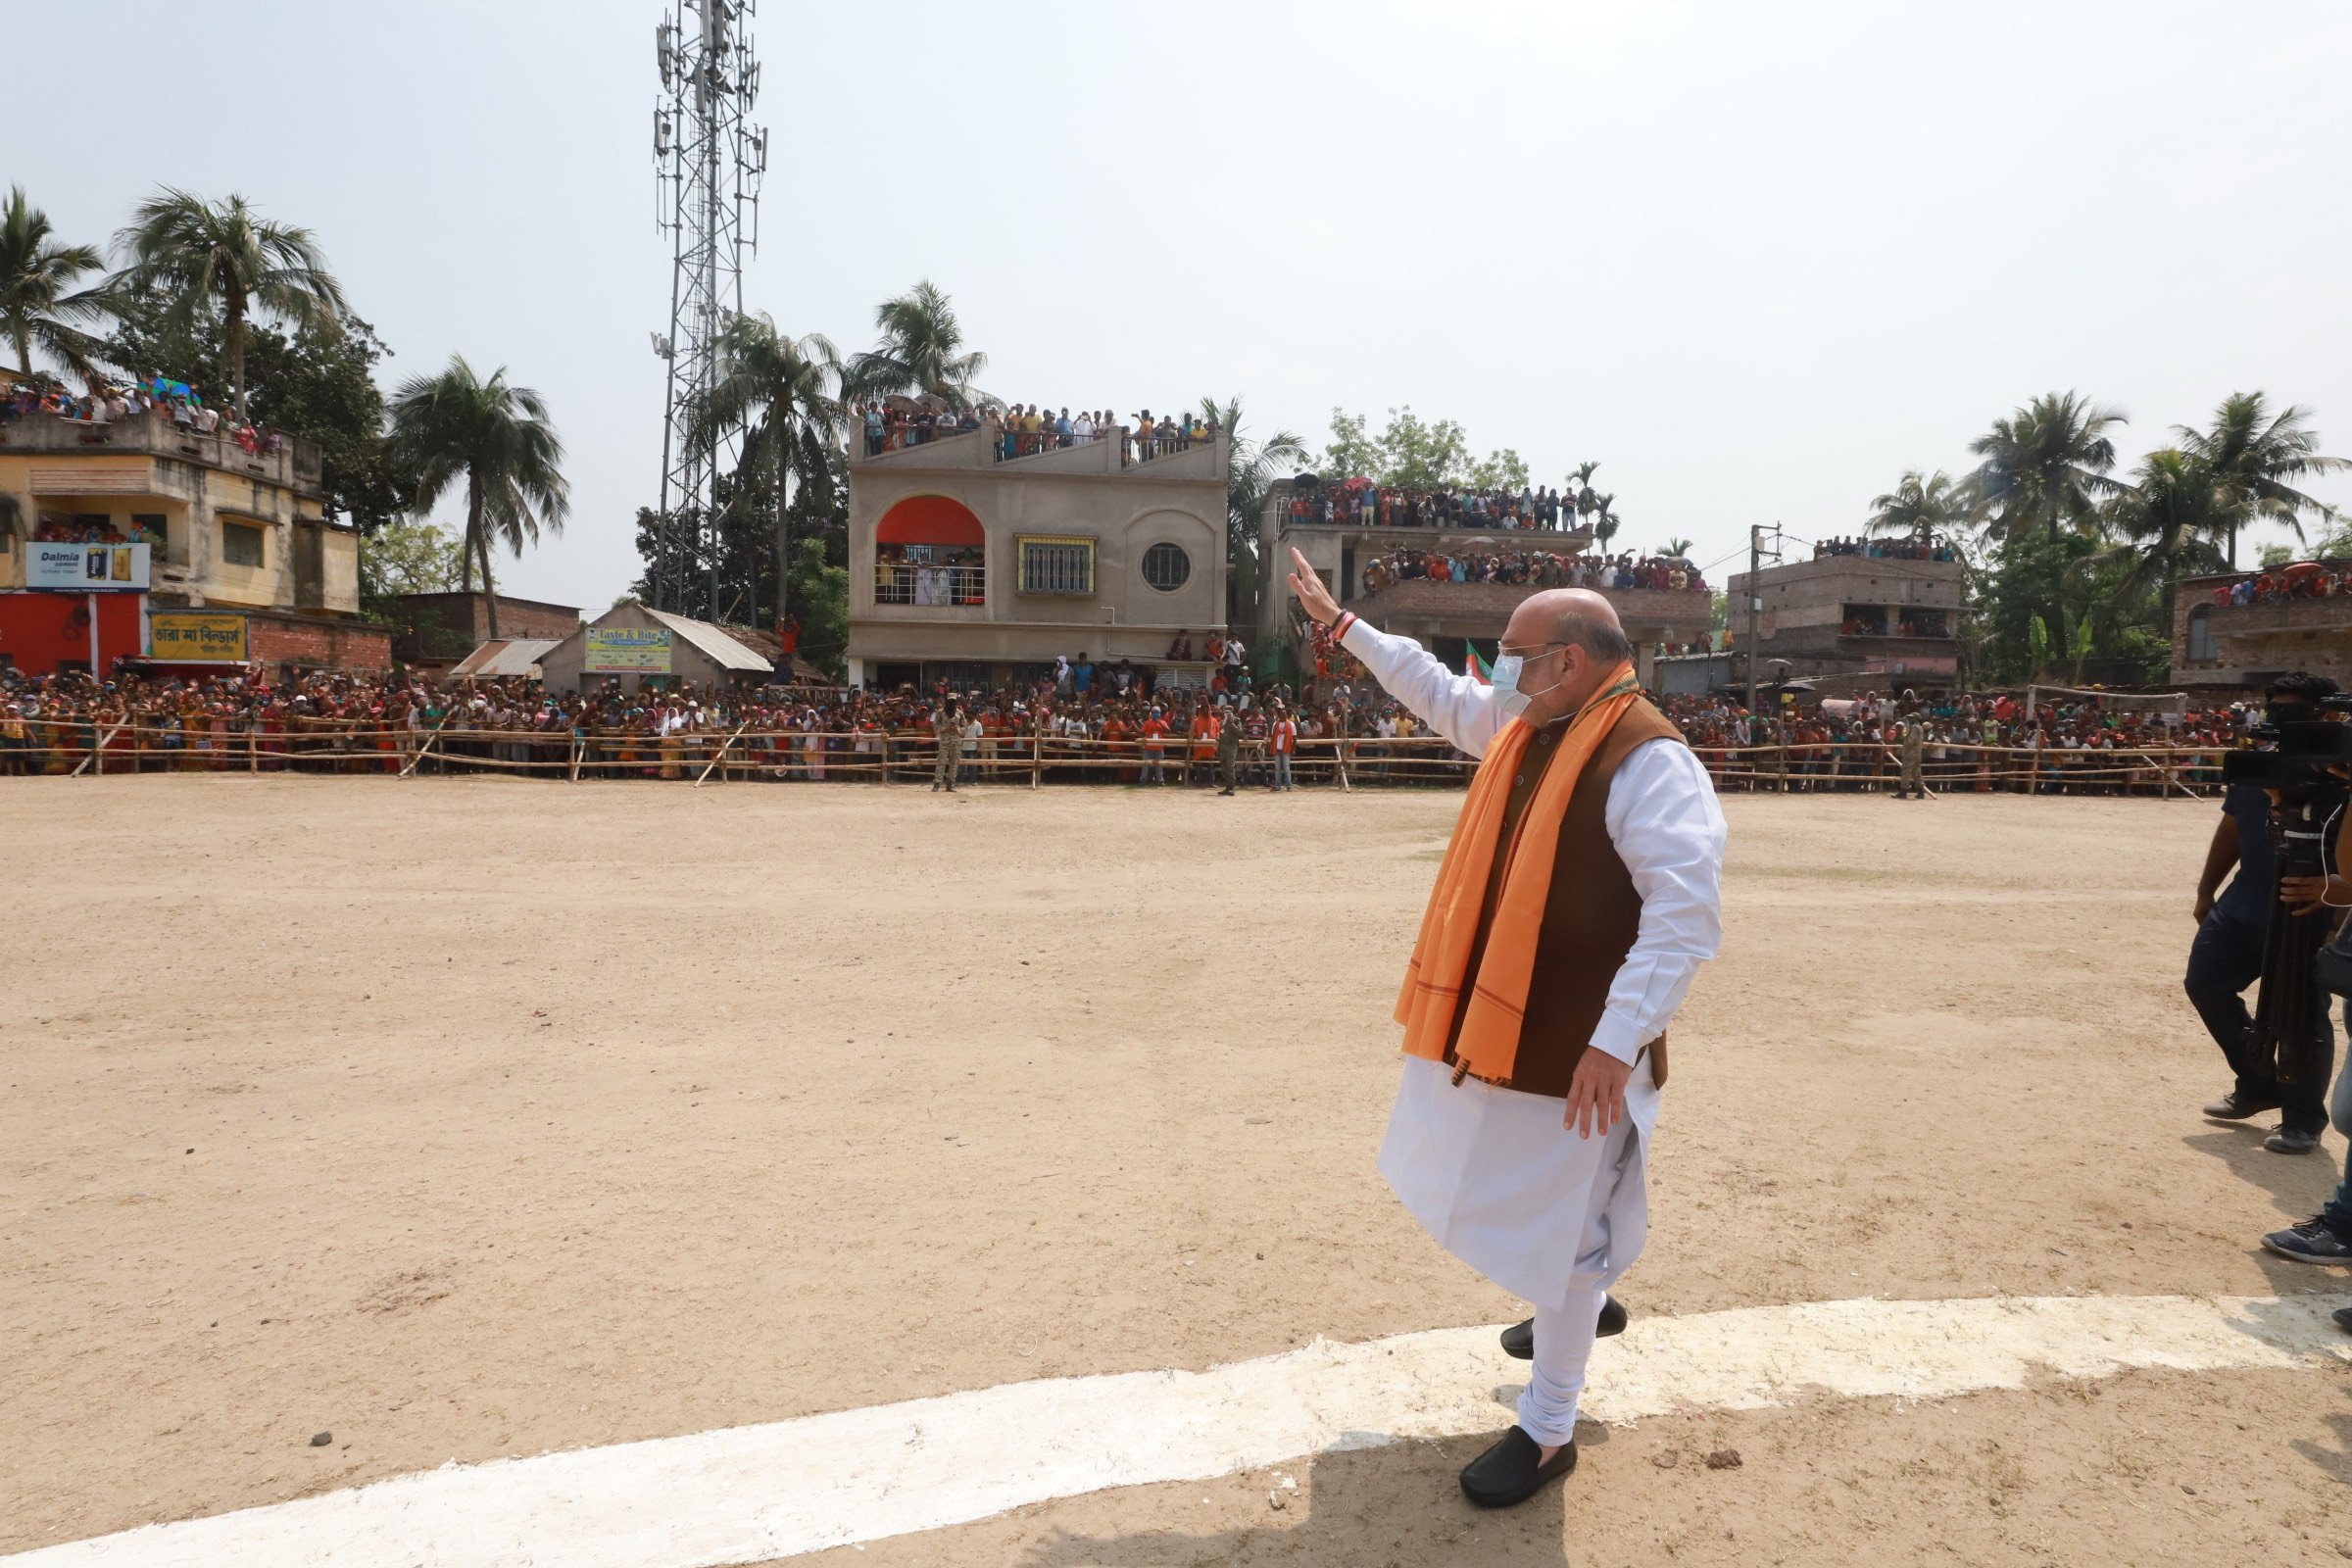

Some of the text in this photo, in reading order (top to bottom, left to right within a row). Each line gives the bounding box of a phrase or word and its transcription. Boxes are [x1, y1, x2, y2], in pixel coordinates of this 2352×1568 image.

[41, 552, 79, 562] Dalmia
[155, 625, 241, 644] তারা মা বিল্ডার্স
[600, 629, 657, 639] Taste & Bite
